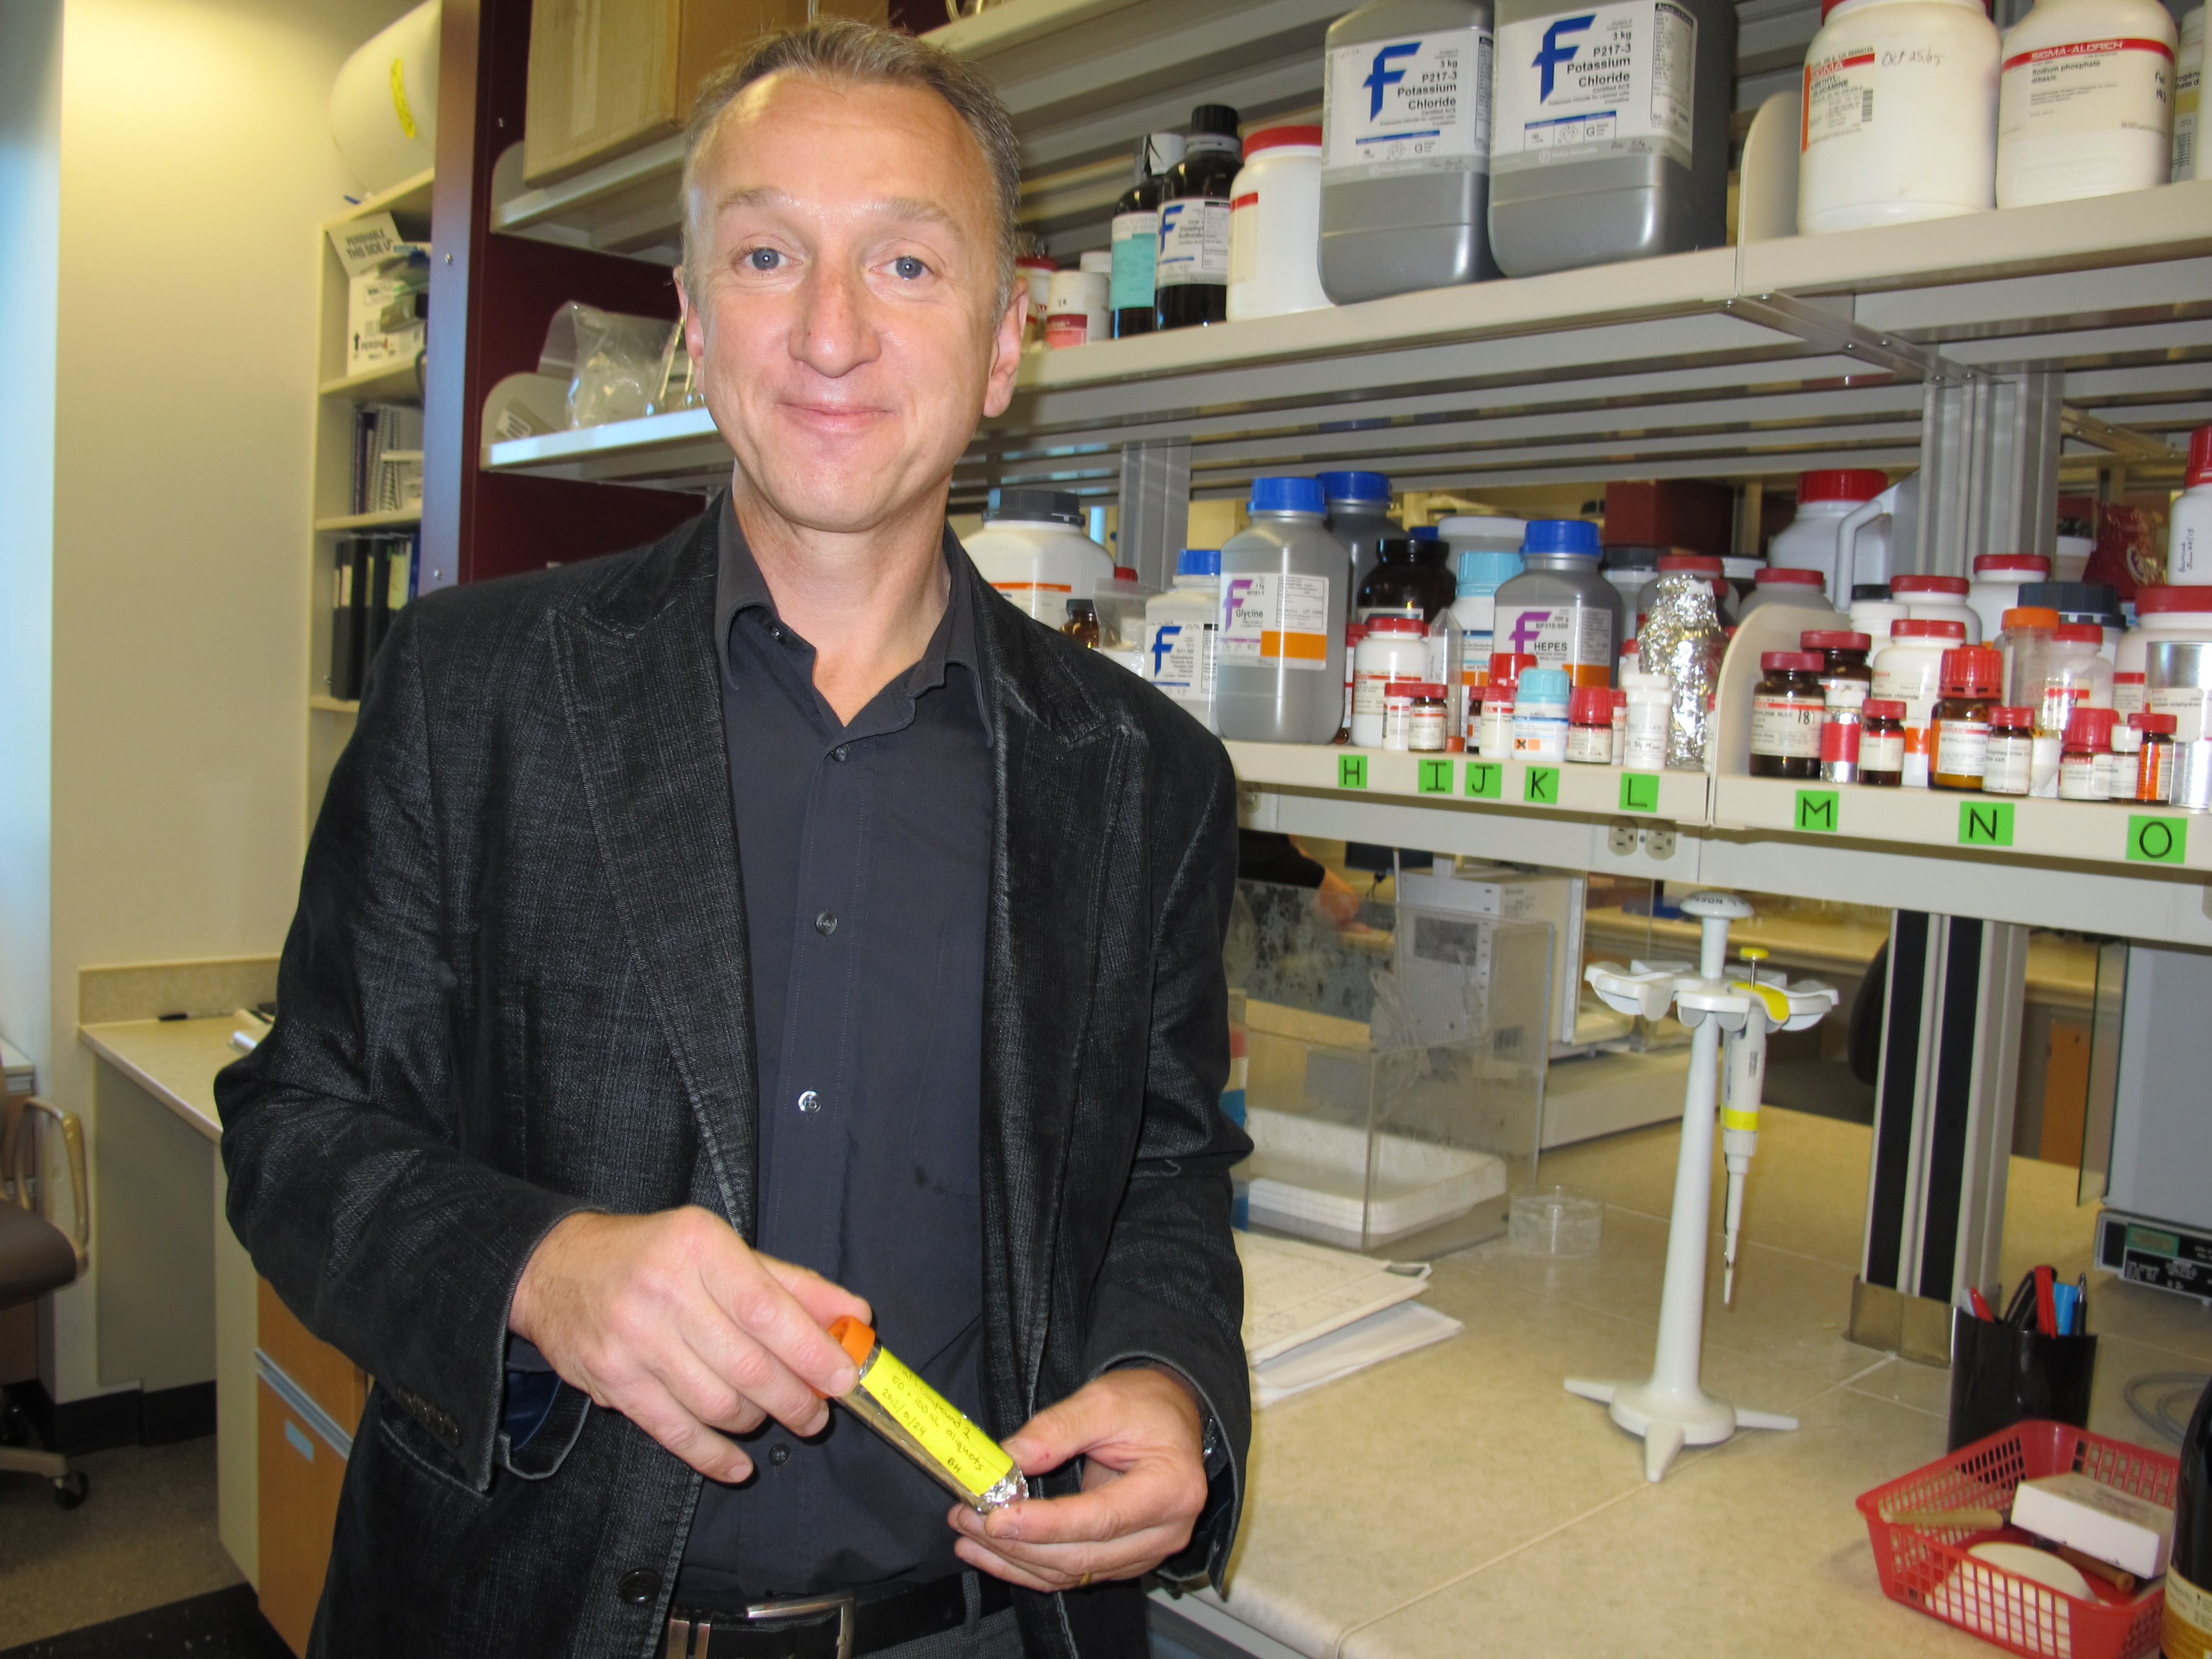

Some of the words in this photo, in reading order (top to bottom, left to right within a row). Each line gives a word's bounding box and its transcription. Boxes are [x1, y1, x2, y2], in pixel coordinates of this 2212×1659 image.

[1613, 32, 1618, 41] 3
[1621, 31, 1632, 40] kg
[1593, 44, 1631, 57] P217-3
[2031, 41, 2123, 60] SIGMA-ALDRICH
[1447, 60, 1458, 69] kg
[1567, 58, 1631, 74] Potassium
[1882, 51, 1905, 67] Oct
[2032, 66, 2059, 76] Sodium
[2060, 61, 2101, 73] phosphate
[1422, 72, 1457, 84] P217-3
[1578, 72, 1630, 88] Chloride
[2031, 75, 2057, 84] dibasic
[1397, 84, 1456, 98] Potassium
[1408, 97, 1456, 110] Chloride
[1236, 609, 1264, 620] Glycine
[1534, 643, 1567, 651] HEPES
[1344, 759, 1360, 785] H
[1427, 762, 1446, 791] I
[1472, 766, 1493, 793] J
[1531, 771, 1549, 799] K
[1627, 778, 1647, 807] L
[1801, 797, 1831, 828] M
[1968, 809, 1997, 841] N
[2139, 821, 2173, 858] O
[892, 1375, 905, 1390] 50
[914, 1397, 929, 1415] 100
[947, 1429, 985, 1472] aliquots
[963, 1427, 971, 1439] 1
[947, 1457, 961, 1473] BH
